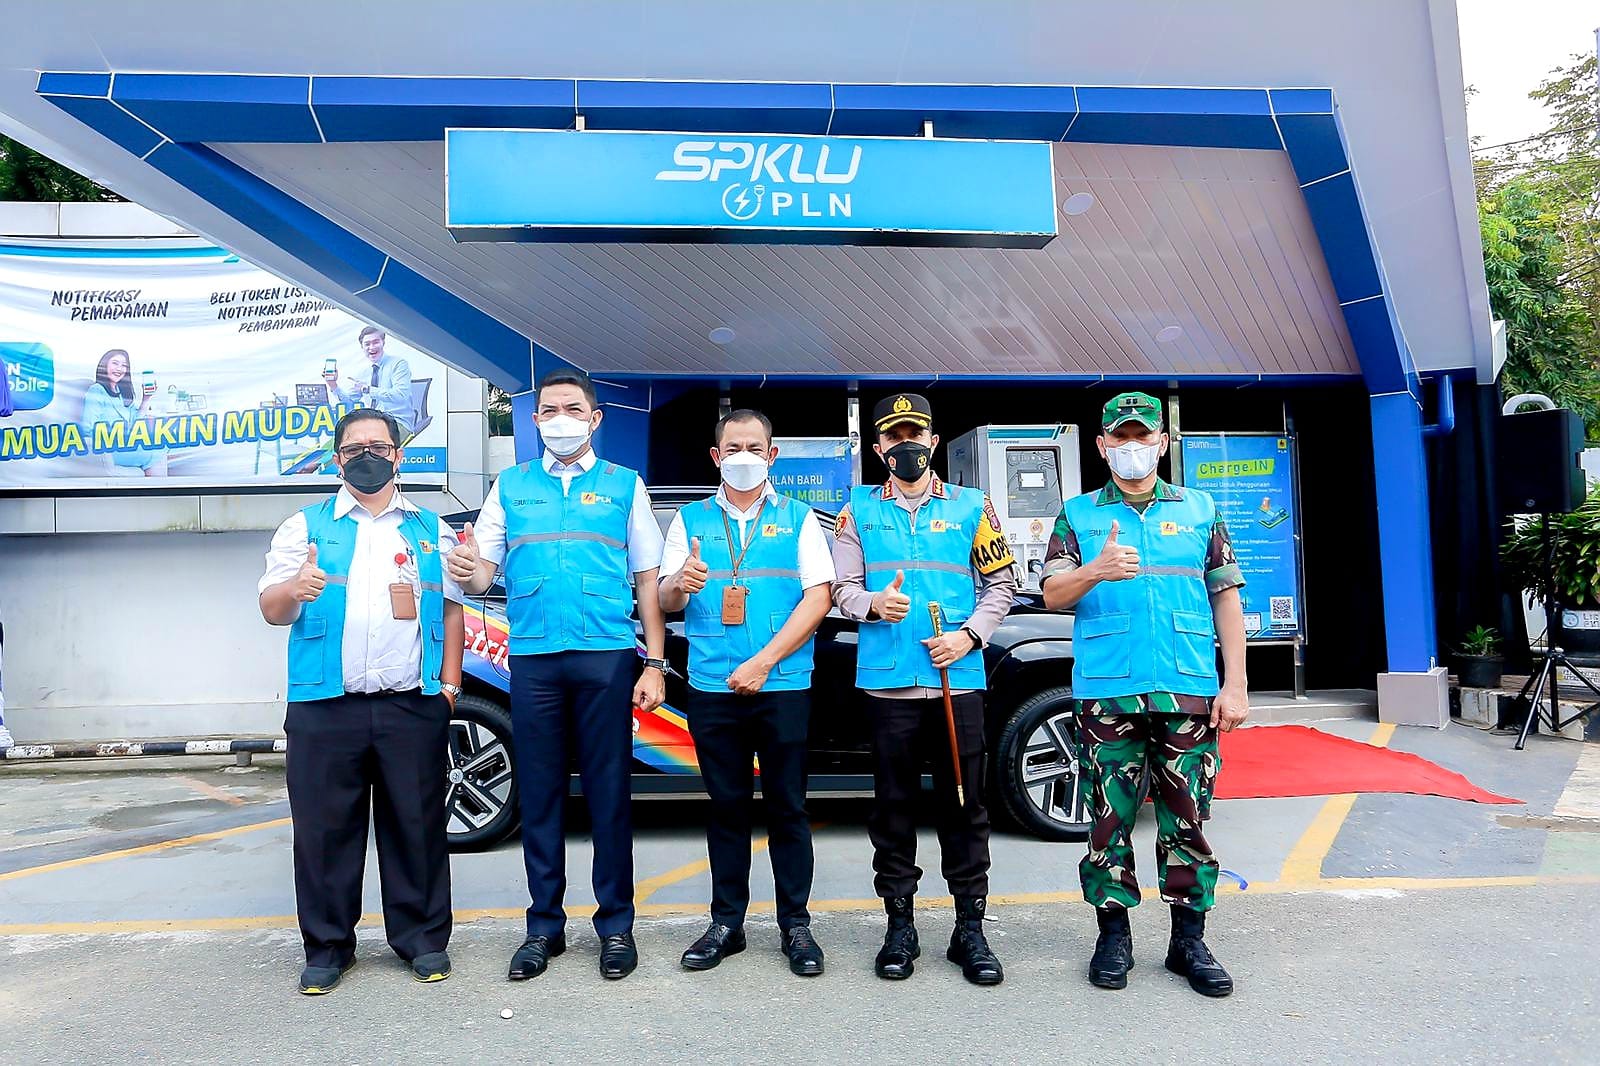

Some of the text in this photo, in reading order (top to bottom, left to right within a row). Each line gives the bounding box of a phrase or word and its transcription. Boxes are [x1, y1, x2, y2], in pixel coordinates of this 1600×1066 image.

[655, 141, 862, 184] SPKLU
[771, 191, 852, 217] PLN
[51, 289, 141, 306] NOTIFIKASI
[209, 286, 313, 305] BELI TOKEN LIS
[71, 301, 169, 321] PEMADAMAN
[217, 303, 287, 320] NOTIFIKASI
[238, 314, 320, 333] PEMBAYARAN
[94, 413, 215, 451] MAKIN
[1199, 460, 1269, 475] Charge.IN
[797, 474, 823, 485] BARU
[797, 489, 844, 502] MOBILE
